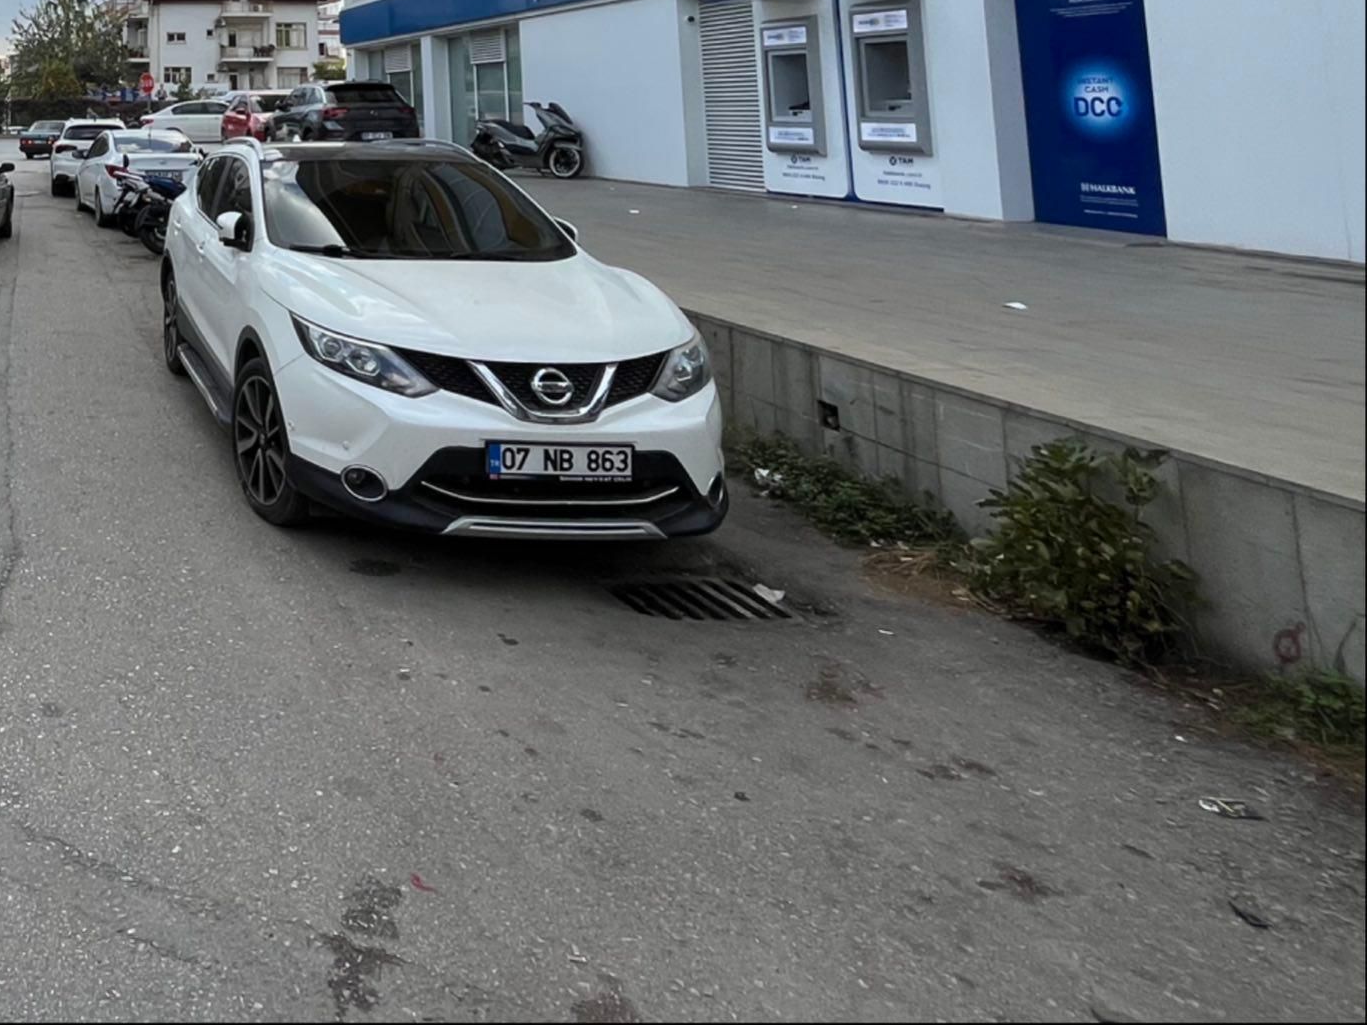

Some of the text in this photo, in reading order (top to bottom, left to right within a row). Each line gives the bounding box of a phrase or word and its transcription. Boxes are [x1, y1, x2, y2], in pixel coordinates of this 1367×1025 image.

[1084, 85, 1109, 94] CASH
[1074, 96, 1123, 118] DCC
[1090, 184, 1136, 195] HALKBANK
[502, 447, 530, 471] 07
[543, 448, 574, 472] NB
[586, 450, 629, 473] 863
